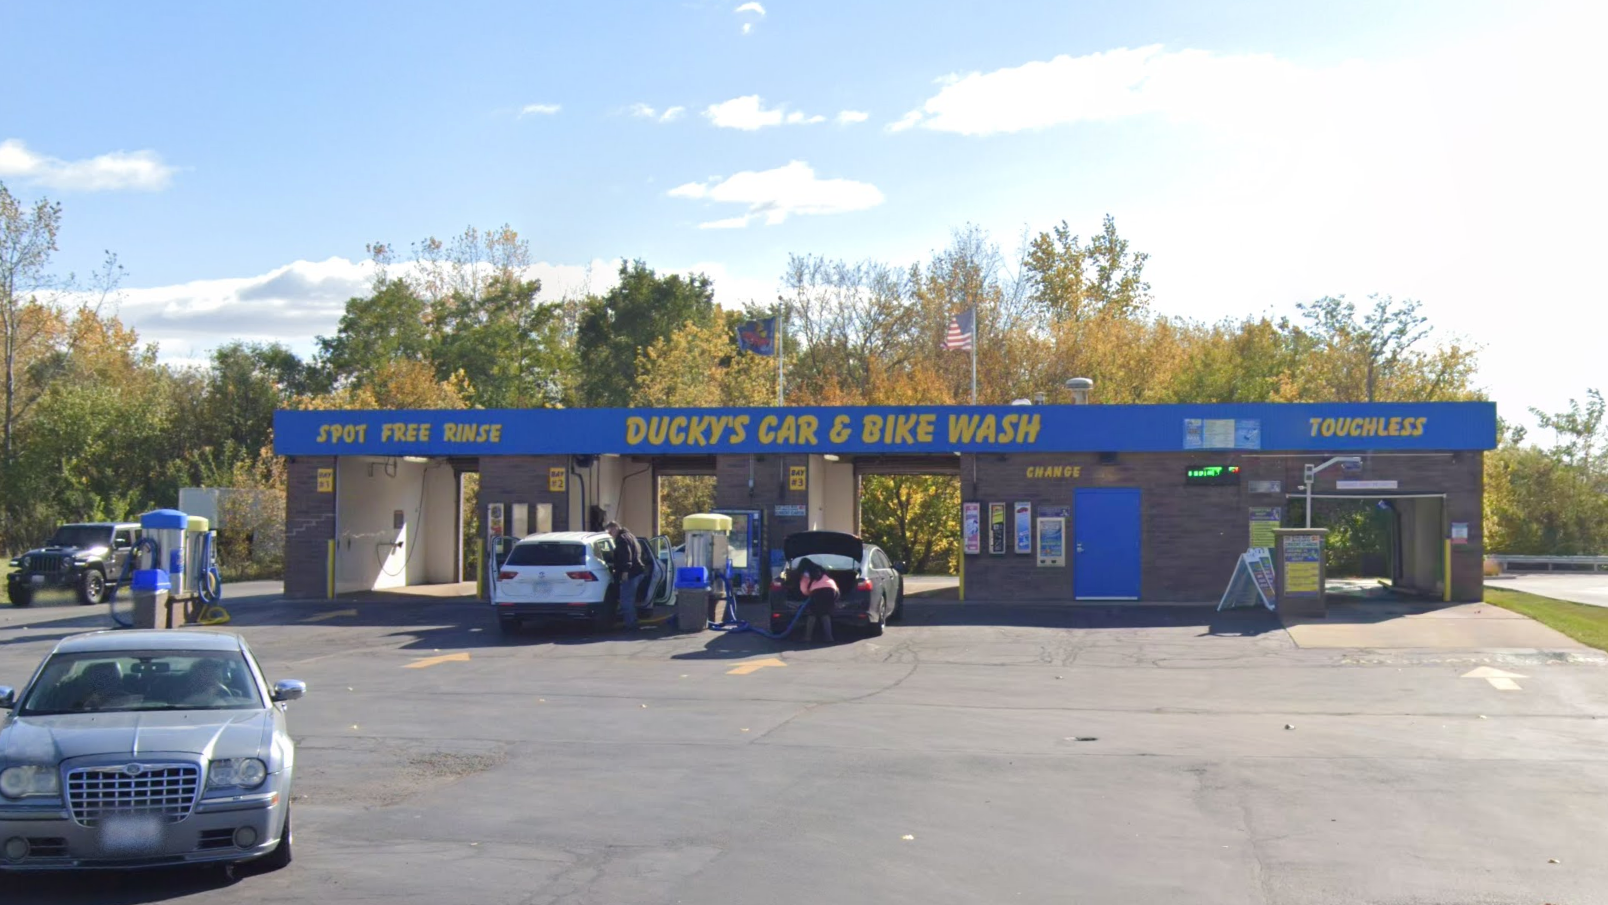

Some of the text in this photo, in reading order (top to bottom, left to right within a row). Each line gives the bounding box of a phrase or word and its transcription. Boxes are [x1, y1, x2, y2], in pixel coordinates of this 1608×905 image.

[317, 423, 502, 443] SPOT FREE RINSE
[626, 413, 1041, 445] DUCKY'S CAR & BIKE WASH
[1309, 417, 1427, 437] TOUCHLESS
[1026, 466, 1082, 479] CHANGE
[552, 479, 563, 488] #2
[791, 478, 803, 486] #3
